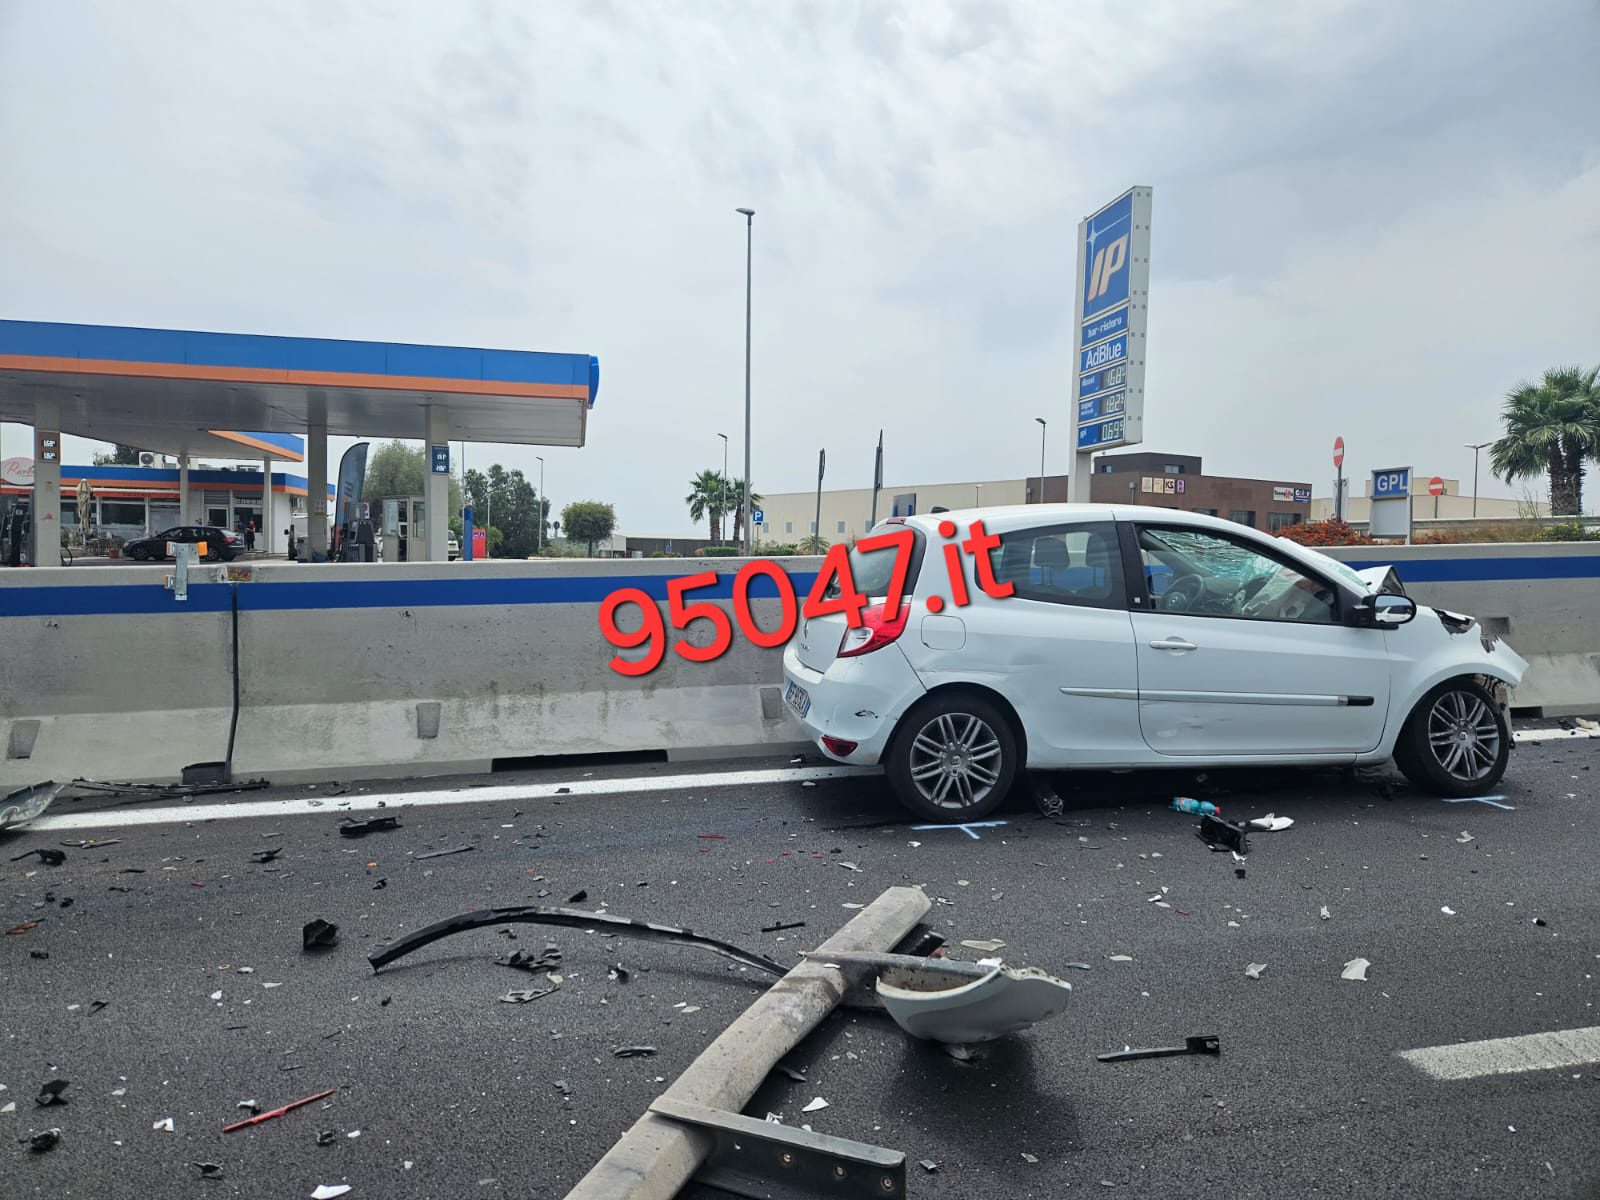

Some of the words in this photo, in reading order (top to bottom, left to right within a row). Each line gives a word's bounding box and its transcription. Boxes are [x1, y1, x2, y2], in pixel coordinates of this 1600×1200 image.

[1088, 233, 1129, 302] IP
[1085, 342, 1122, 369] AdBlue
[1377, 473, 1408, 491] GPL
[754, 511, 762, 521] P
